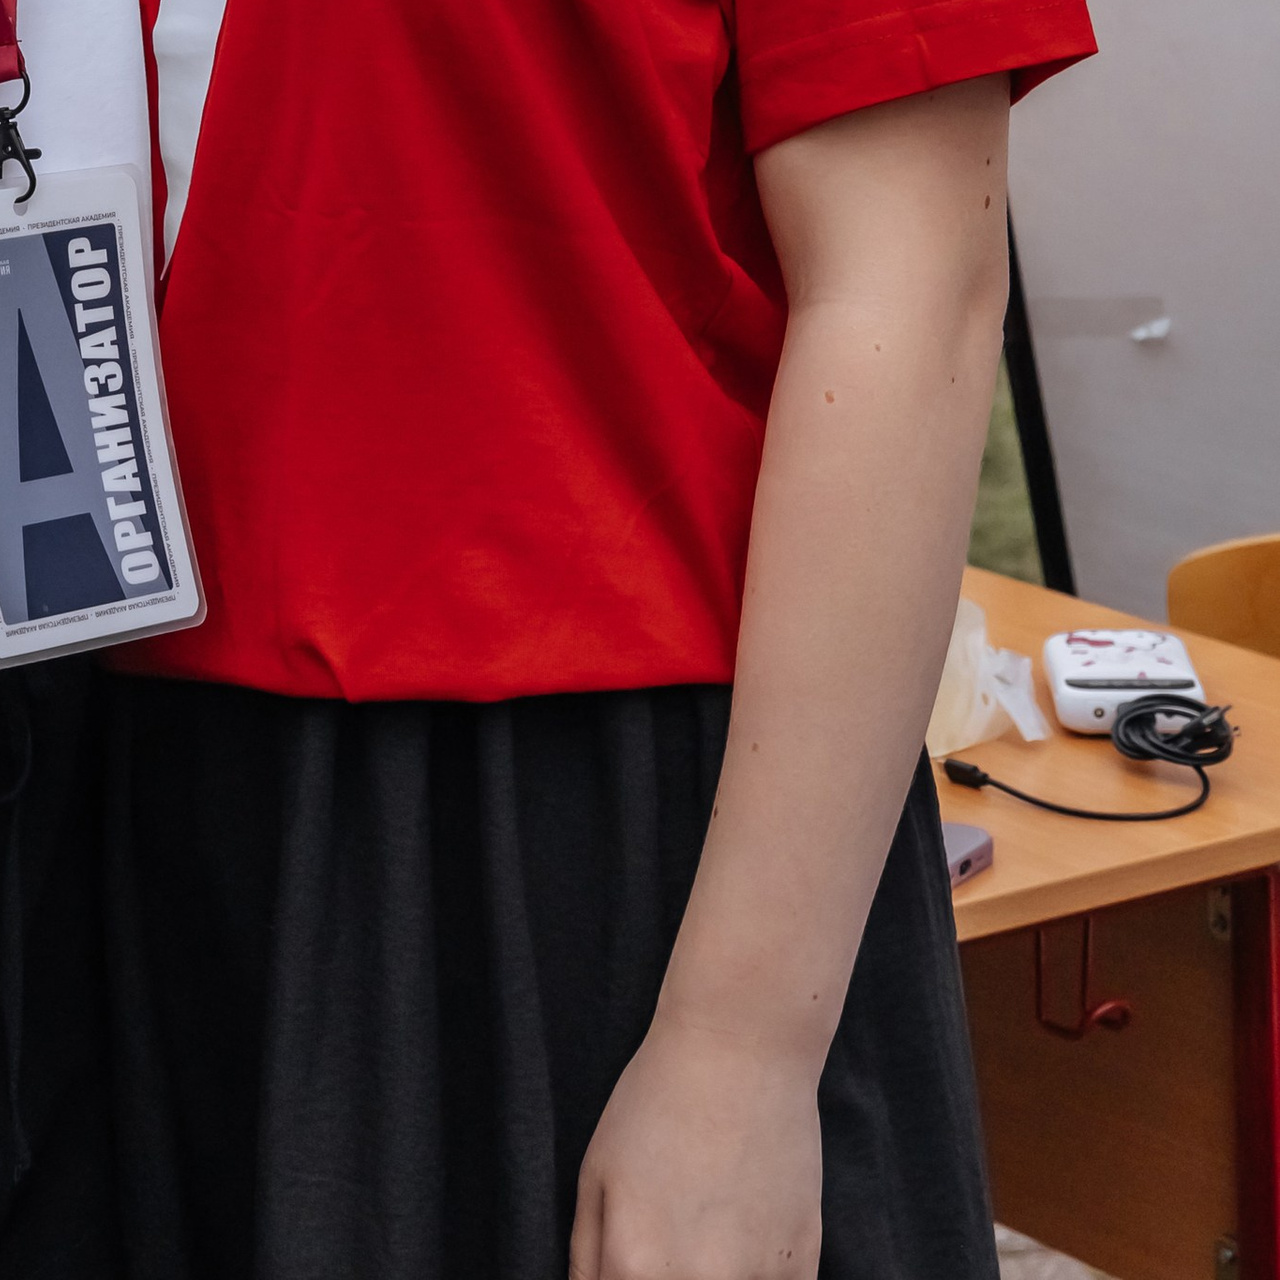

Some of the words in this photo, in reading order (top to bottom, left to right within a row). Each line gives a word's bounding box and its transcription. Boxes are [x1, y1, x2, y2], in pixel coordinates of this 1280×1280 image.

[27, 216, 80, 230] ПРЕЗИДЕНТСКАЯ
[81, 211, 116, 222] АКАДЕМИЯ
[67, 237, 160, 585] ОРГАНИЗАТОР
[132, 349, 146, 417] ПРЕЗИДЕНТСКАЯ
[141, 418, 154, 464] АКАДЕМИЯ
